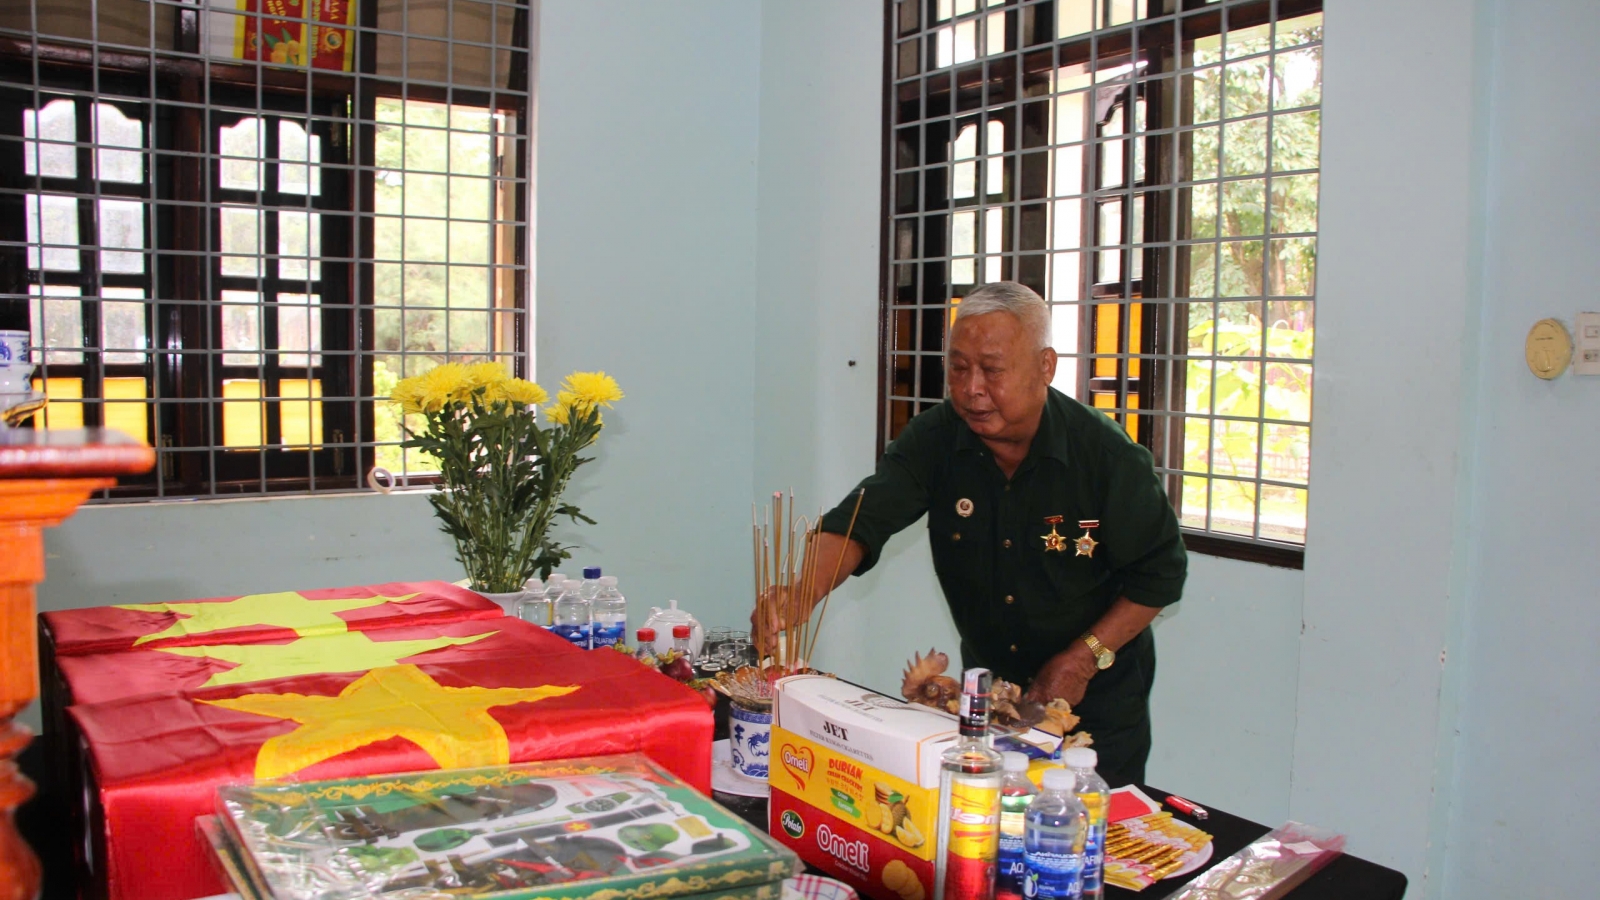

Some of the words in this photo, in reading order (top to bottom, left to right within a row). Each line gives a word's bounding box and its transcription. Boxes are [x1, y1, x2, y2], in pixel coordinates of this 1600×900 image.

[823, 720, 849, 741] JET
[784, 751, 809, 773] Omeli
[828, 758, 863, 781] DURIAN
[816, 823, 870, 873] Omeli
